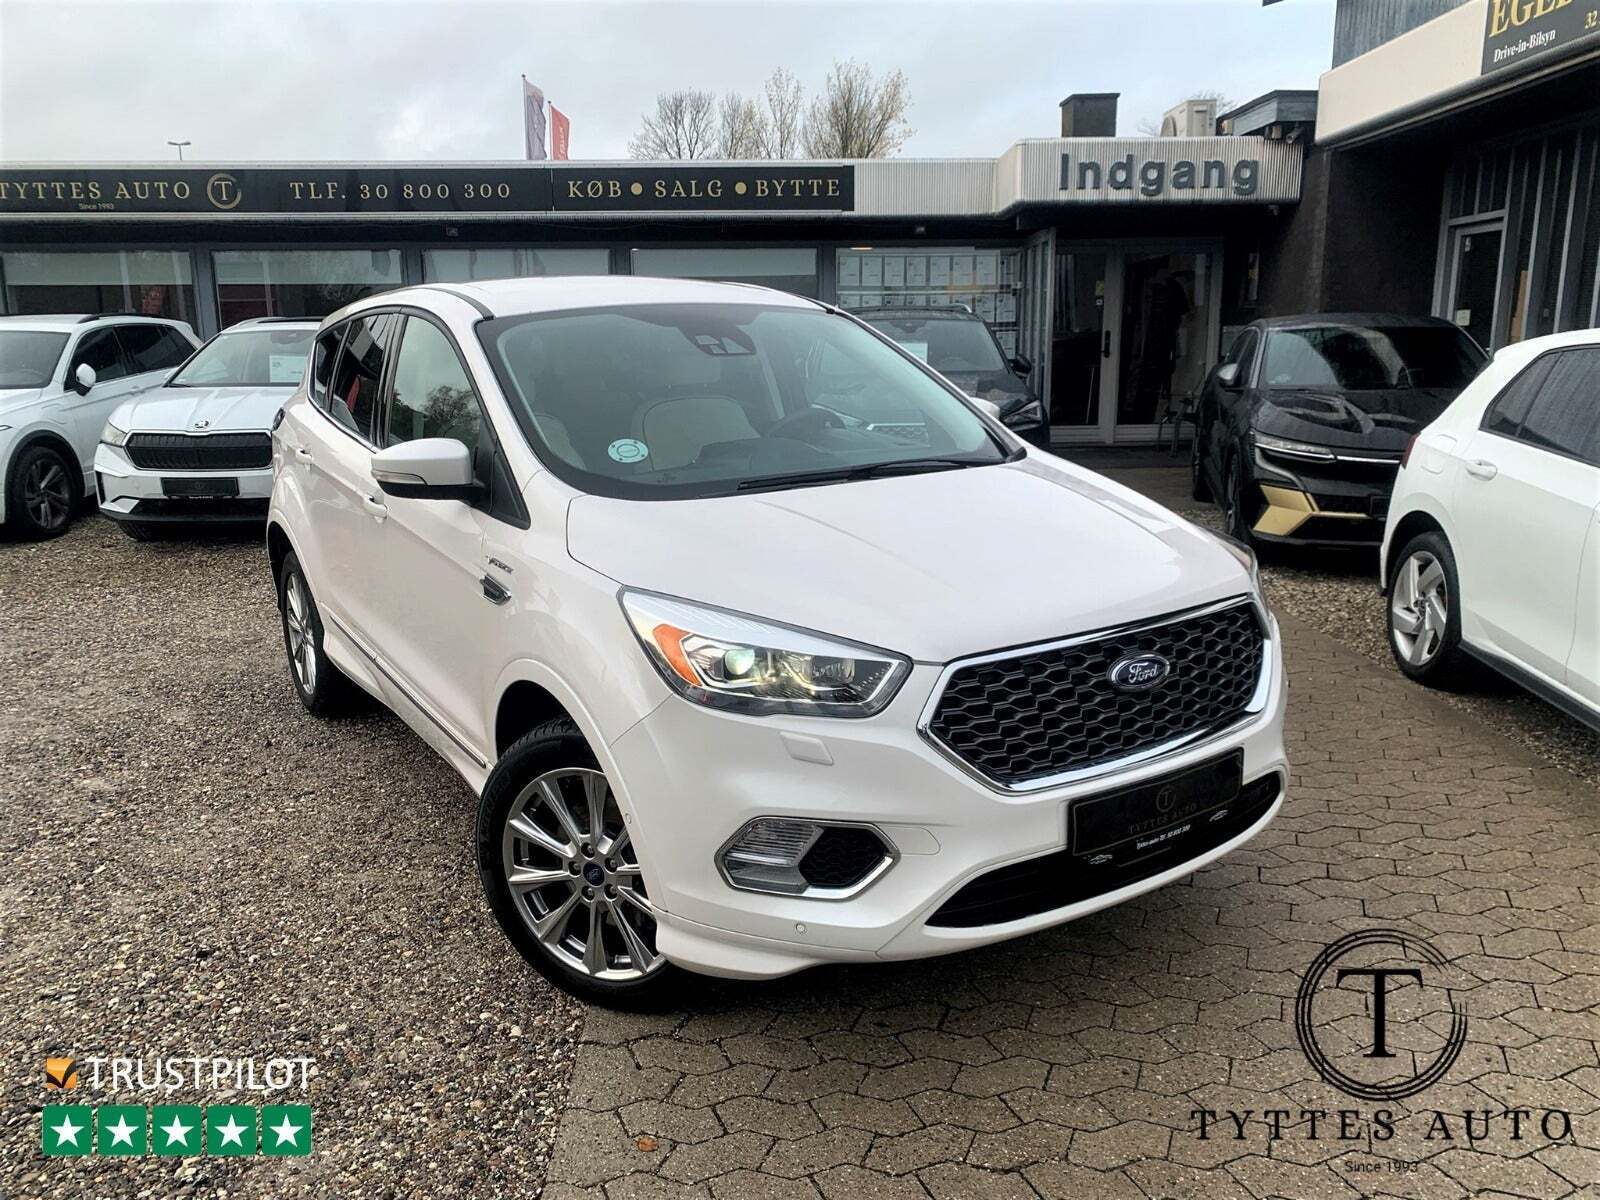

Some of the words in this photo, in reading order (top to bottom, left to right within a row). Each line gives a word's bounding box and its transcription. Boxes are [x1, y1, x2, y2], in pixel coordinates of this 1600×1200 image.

[1488, 0, 1574, 38] EG
[1059, 152, 1260, 196] Indgang
[0, 181, 101, 200] TYTTES
[115, 181, 191, 199] AUTO
[290, 182, 347, 200] TLF.
[360, 184, 389, 200] 30
[402, 184, 450, 199] 800
[464, 183, 510, 199] 300
[567, 179, 622, 198] KØB
[654, 179, 724, 198] SALG
[755, 179, 841, 197] BYTTE
[1128, 662, 1159, 683] Ford
